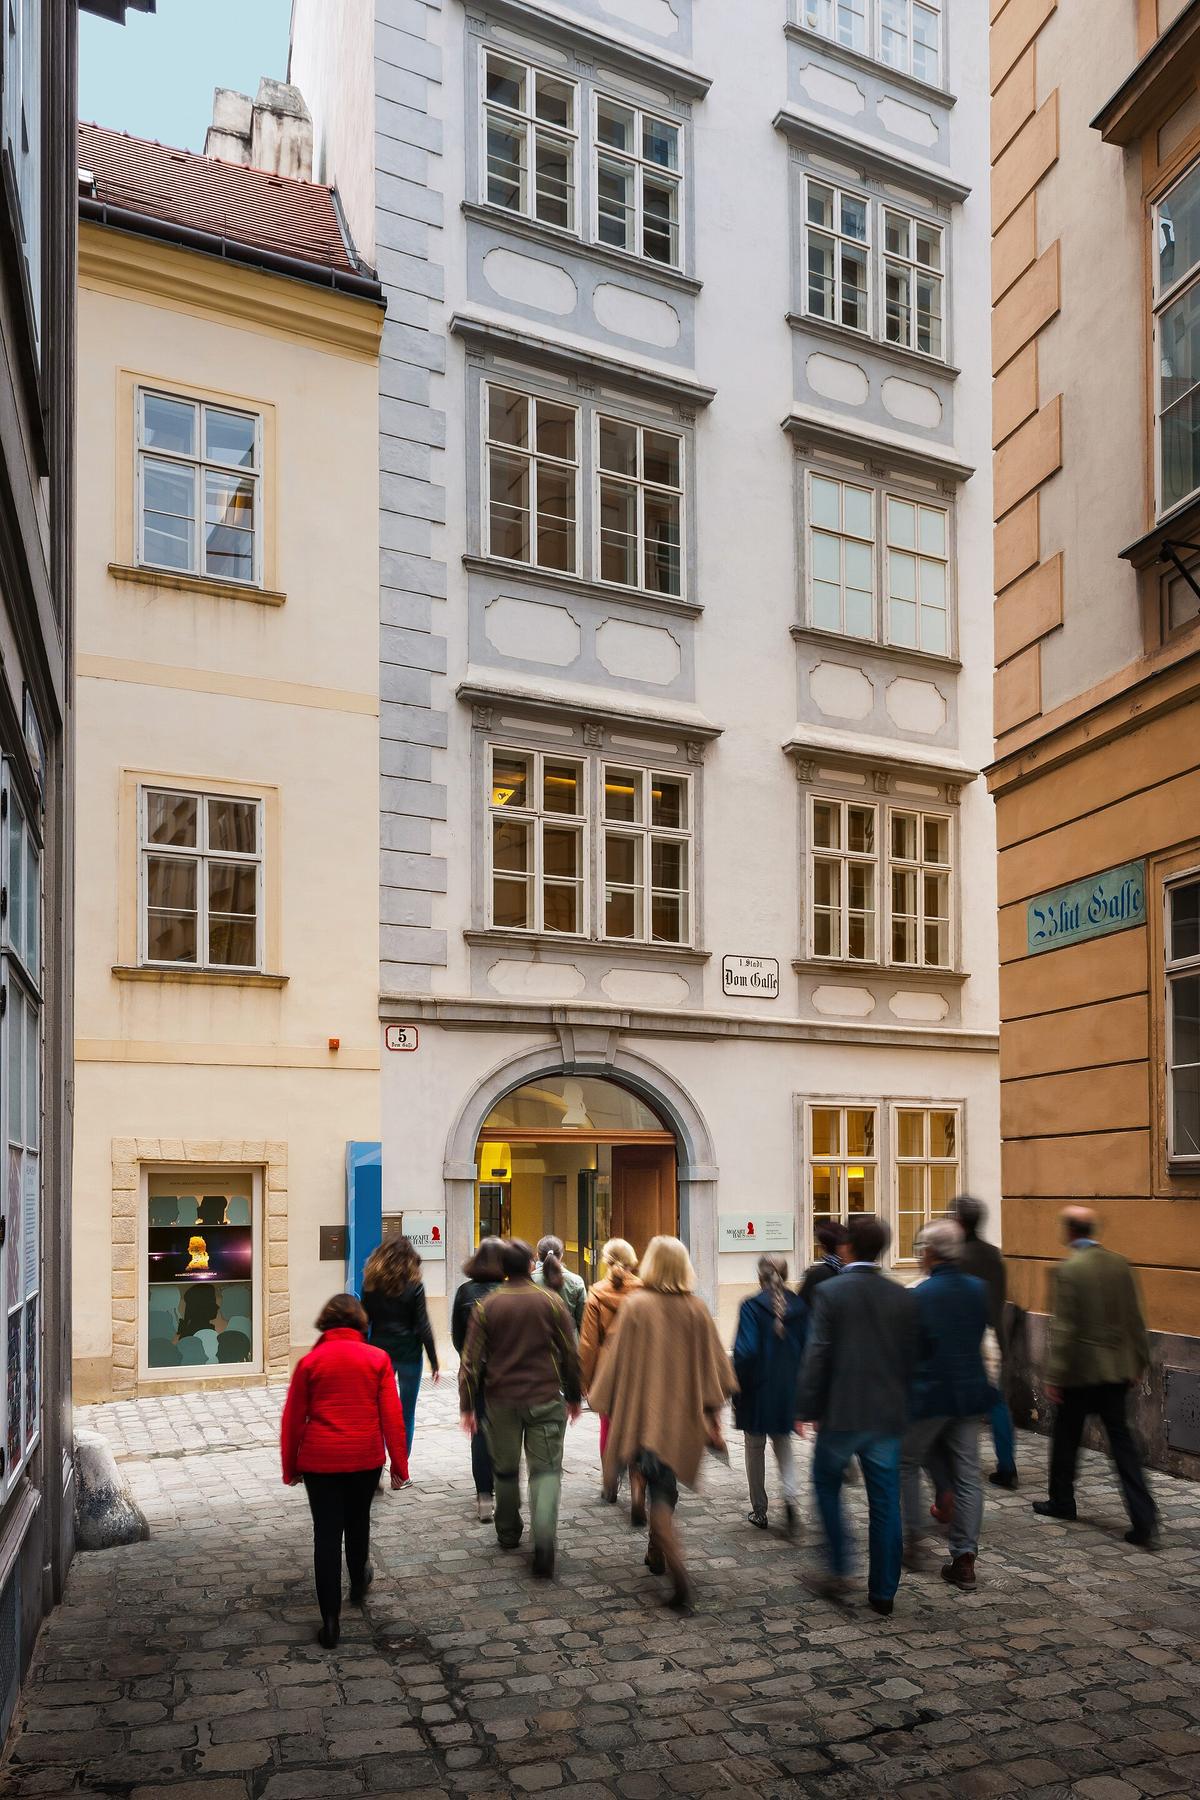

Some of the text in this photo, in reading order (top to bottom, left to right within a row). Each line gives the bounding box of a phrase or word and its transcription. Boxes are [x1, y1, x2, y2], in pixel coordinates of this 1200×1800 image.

[745, 959, 763, 968] Stadt
[725, 969, 748, 987] Dom
[398, 1028, 407, 1043] 5
